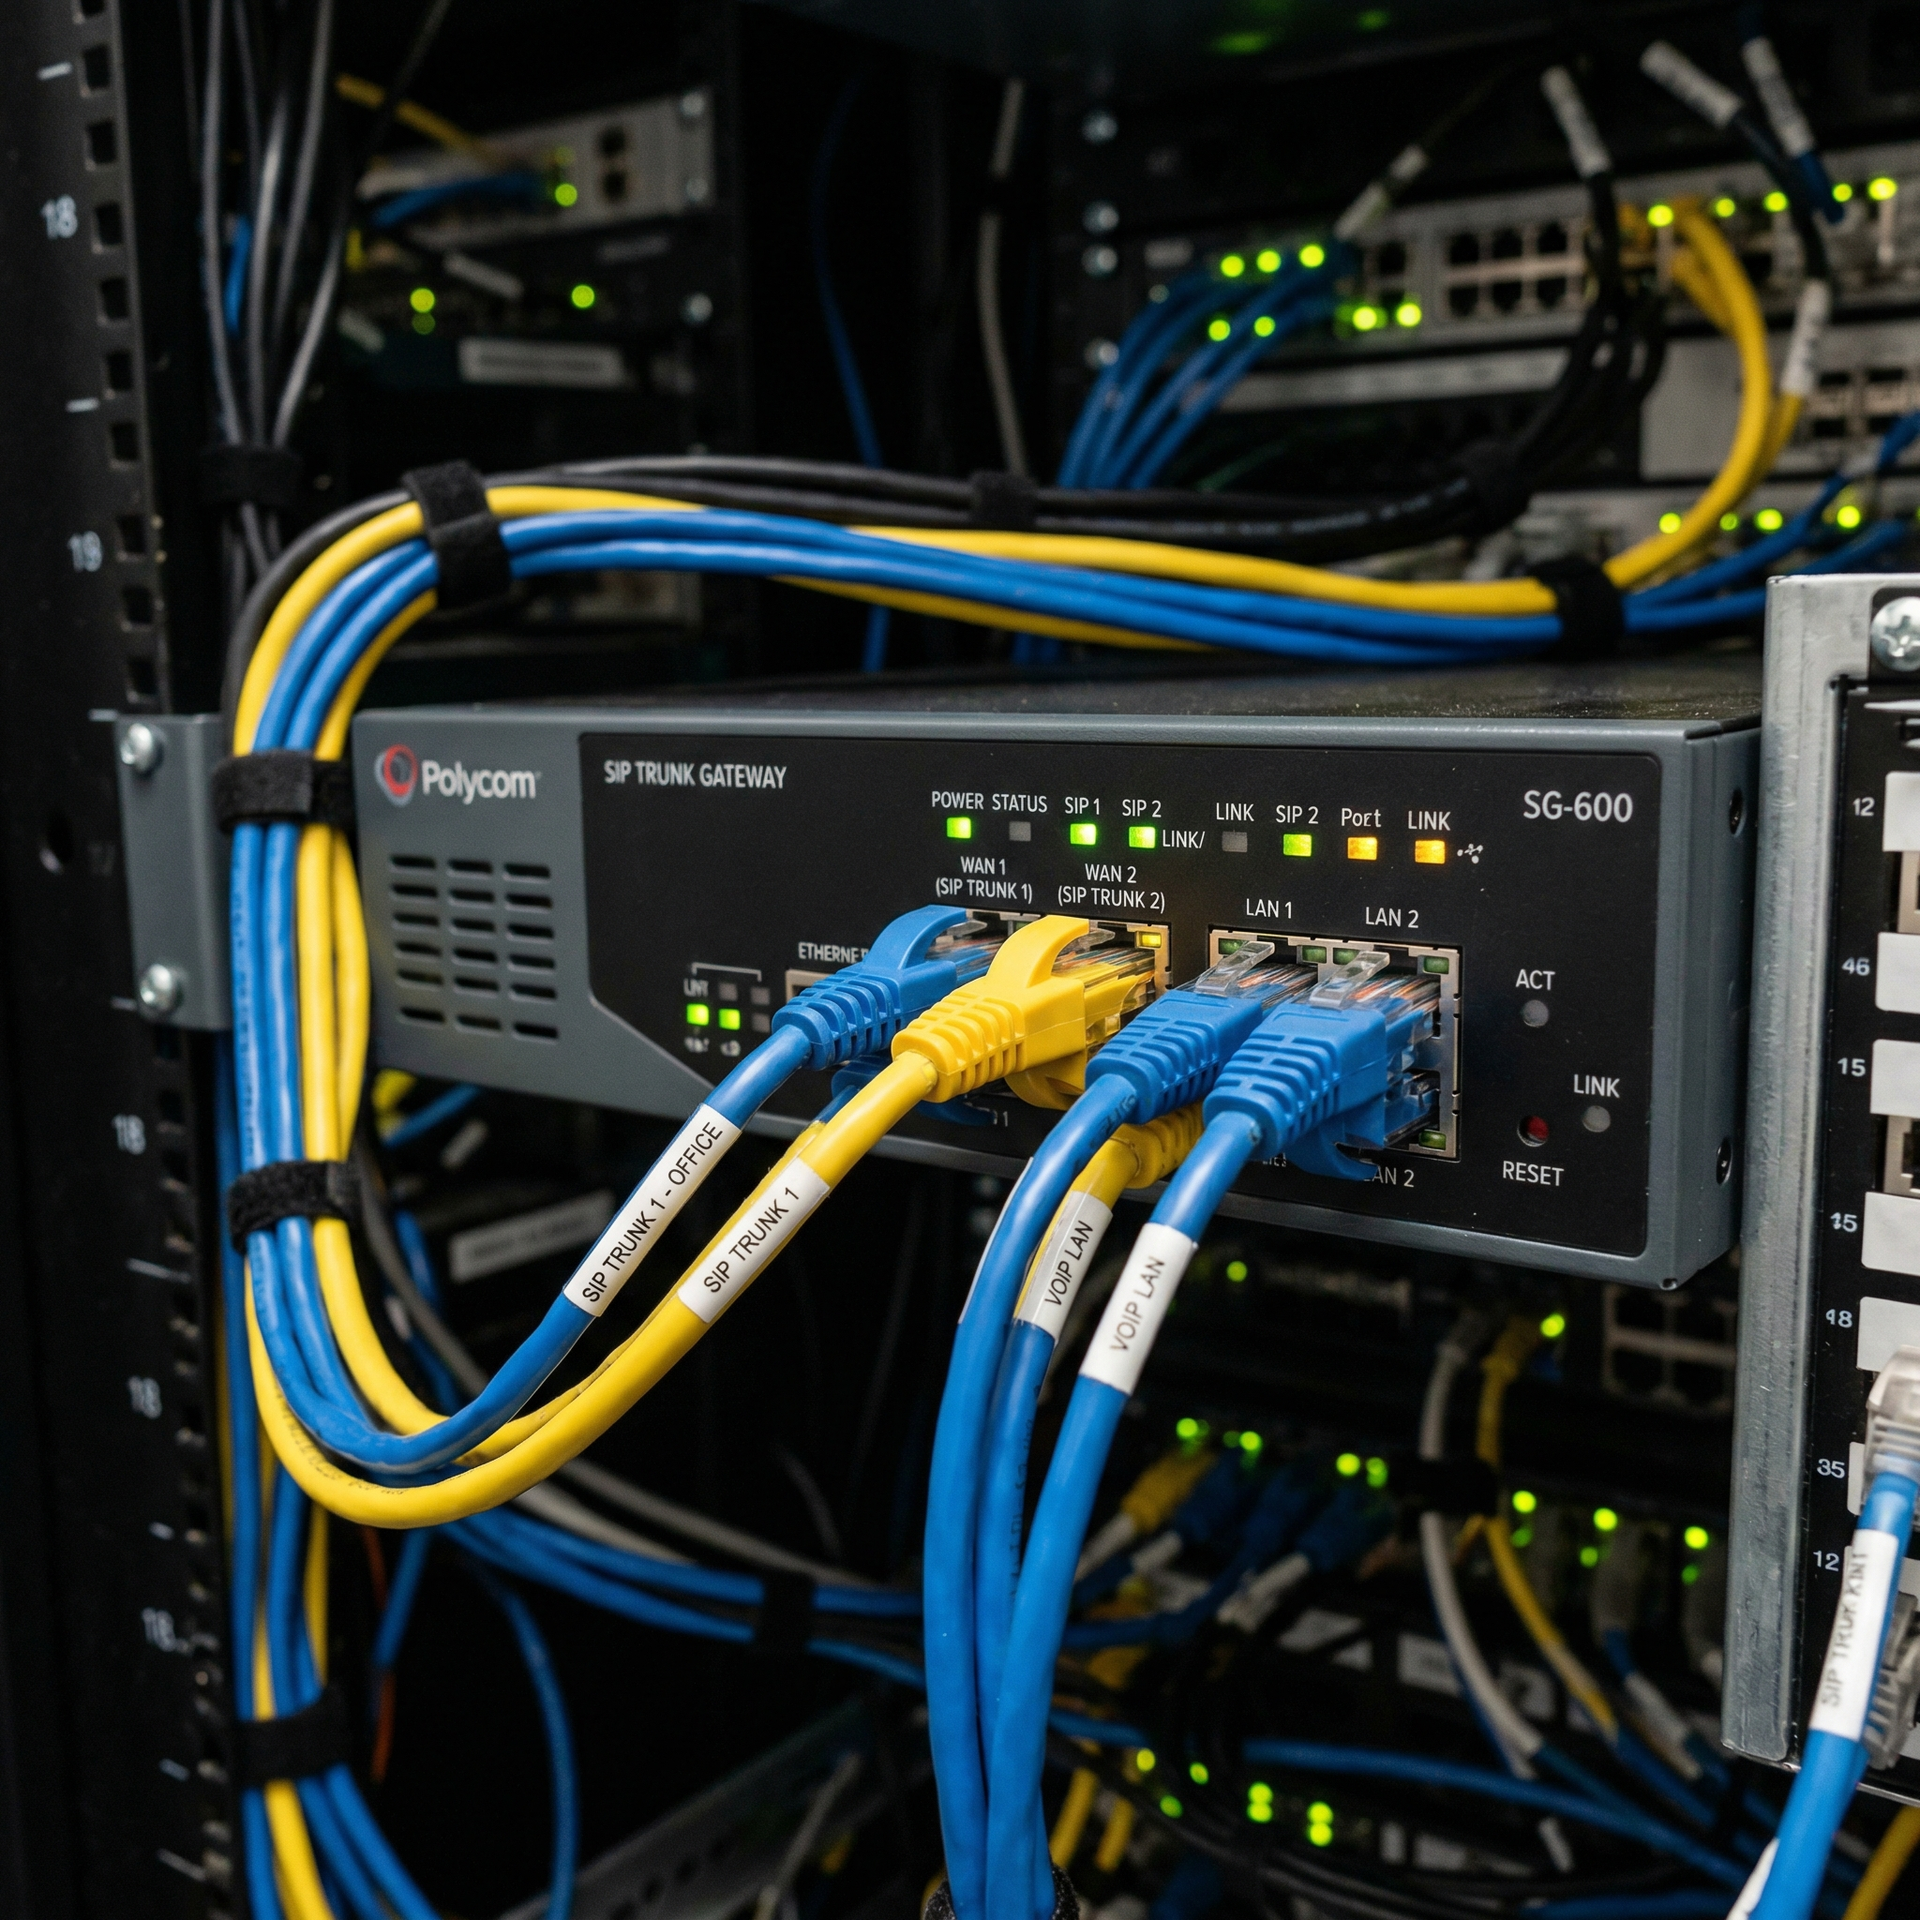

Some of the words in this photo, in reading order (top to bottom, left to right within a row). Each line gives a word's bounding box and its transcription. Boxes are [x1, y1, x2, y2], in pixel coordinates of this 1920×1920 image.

[422, 759, 537, 805] Polycom
[604, 759, 631, 785] SIP
[636, 760, 696, 787] TRUNK
[699, 763, 787, 790] GATEWAY
[931, 790, 984, 810] POWER
[992, 794, 1048, 813] STATUS
[1065, 797, 1089, 814] SIP
[1093, 799, 1100, 815] 1
[1122, 800, 1147, 817] SIP
[1151, 801, 1162, 818] 2
[1523, 790, 1634, 823] SG-600
[1853, 796, 1876, 817] 12
[1216, 803, 1255, 822] LINK
[1276, 805, 1303, 824] SIP
[1308, 807, 1319, 825] 2
[1341, 808, 1382, 828] Port
[1408, 811, 1451, 831] LINK
[1162, 829, 1206, 849] LINK/
[960, 856, 996, 875] WAN
[998, 859, 1006, 875] 1
[1085, 863, 1122, 882] WAN
[1127, 866, 1137, 884] 2
[935, 877, 963, 897] (SIP
[967, 879, 1018, 900] TRUNK
[1021, 883, 1033, 904] 1)
[1057, 885, 1087, 906] (SIP
[1091, 887, 1146, 909] TRUNK
[1149, 891, 1166, 914] 2)
[1246, 898, 1280, 918] LAN
[1285, 902, 1293, 919] 1
[1365, 906, 1402, 927] LAN
[1407, 910, 1420, 929] 2
[1842, 957, 1871, 976] 46
[1516, 969, 1555, 991] ACT
[1837, 1057, 1866, 1077] 15
[1574, 1074, 1620, 1098] LINK
[1363, 1165, 1397, 1185] AN
[1403, 1169, 1415, 1188] 2
[1503, 1161, 1564, 1186] RESET
[582, 1271, 608, 1303] SIP
[602, 1211, 657, 1272] TRUNK
[650, 1198, 666, 1210] 1
[667, 1121, 724, 1187] OFFICE
[703, 1260, 732, 1293] SIP
[728, 1199, 790, 1262] TRUNK
[784, 1187, 800, 1201] 1
[1044, 1260, 1073, 1306] VOIP
[1064, 1220, 1094, 1261] LAN
[1109, 1301, 1143, 1352] VOIP
[1133, 1256, 1166, 1299] LAN
[1816, 1458, 1846, 1479] 35
[1812, 1550, 1840, 1572] 12
